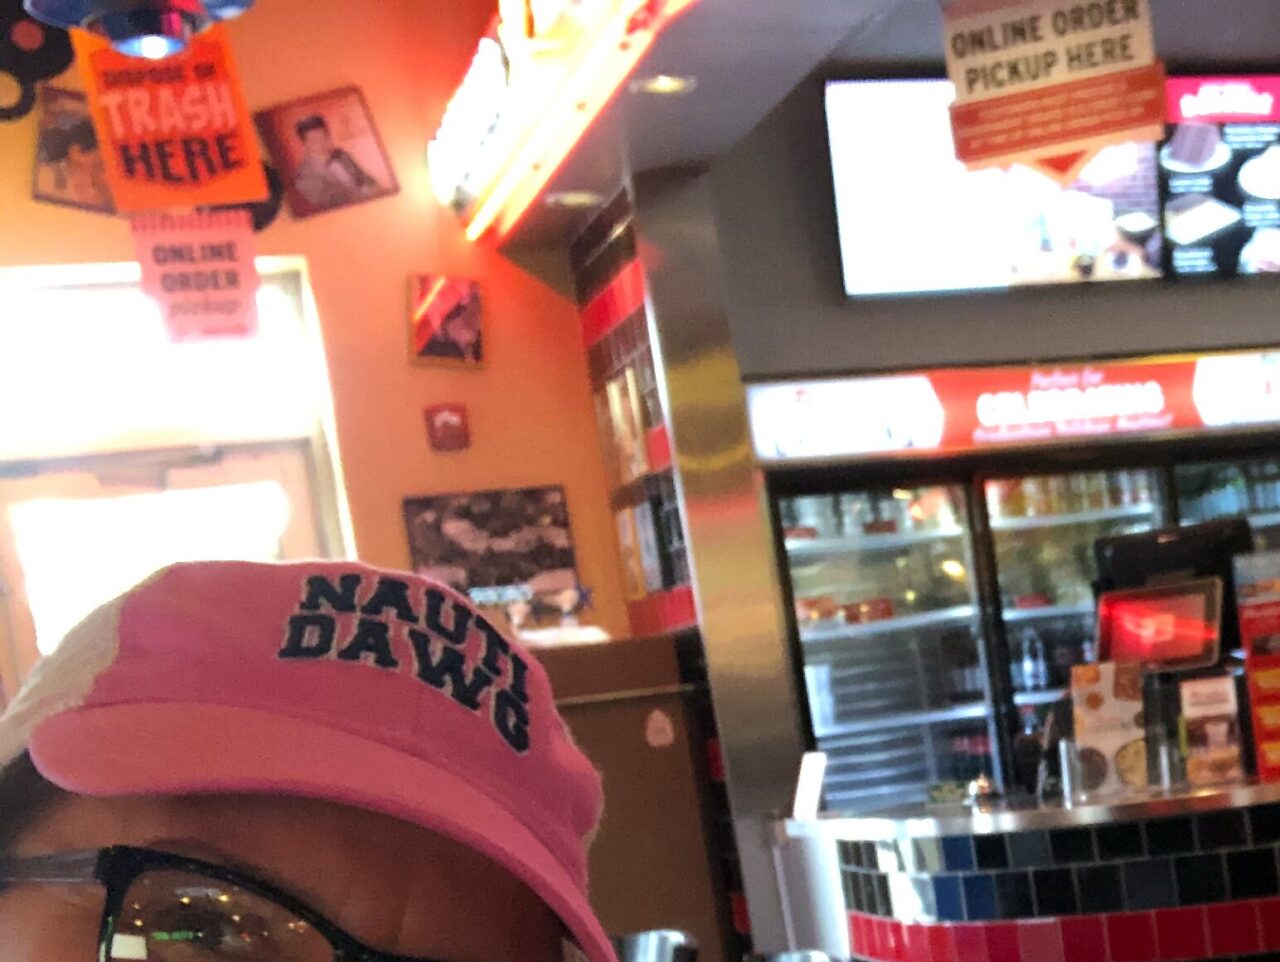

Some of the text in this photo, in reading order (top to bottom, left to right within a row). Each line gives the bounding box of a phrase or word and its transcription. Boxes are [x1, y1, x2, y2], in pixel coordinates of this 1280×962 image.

[952, 0, 1139, 59] ONLINE ORDER
[965, 33, 1134, 94] PICKUP HERE
[102, 82, 239, 140] TRASH
[120, 131, 243, 182] HERE
[152, 241, 239, 266] ONLINE
[160, 269, 241, 293] ORDER
[299, 573, 530, 705] NAUTI
[277, 612, 530, 754] DAWG
